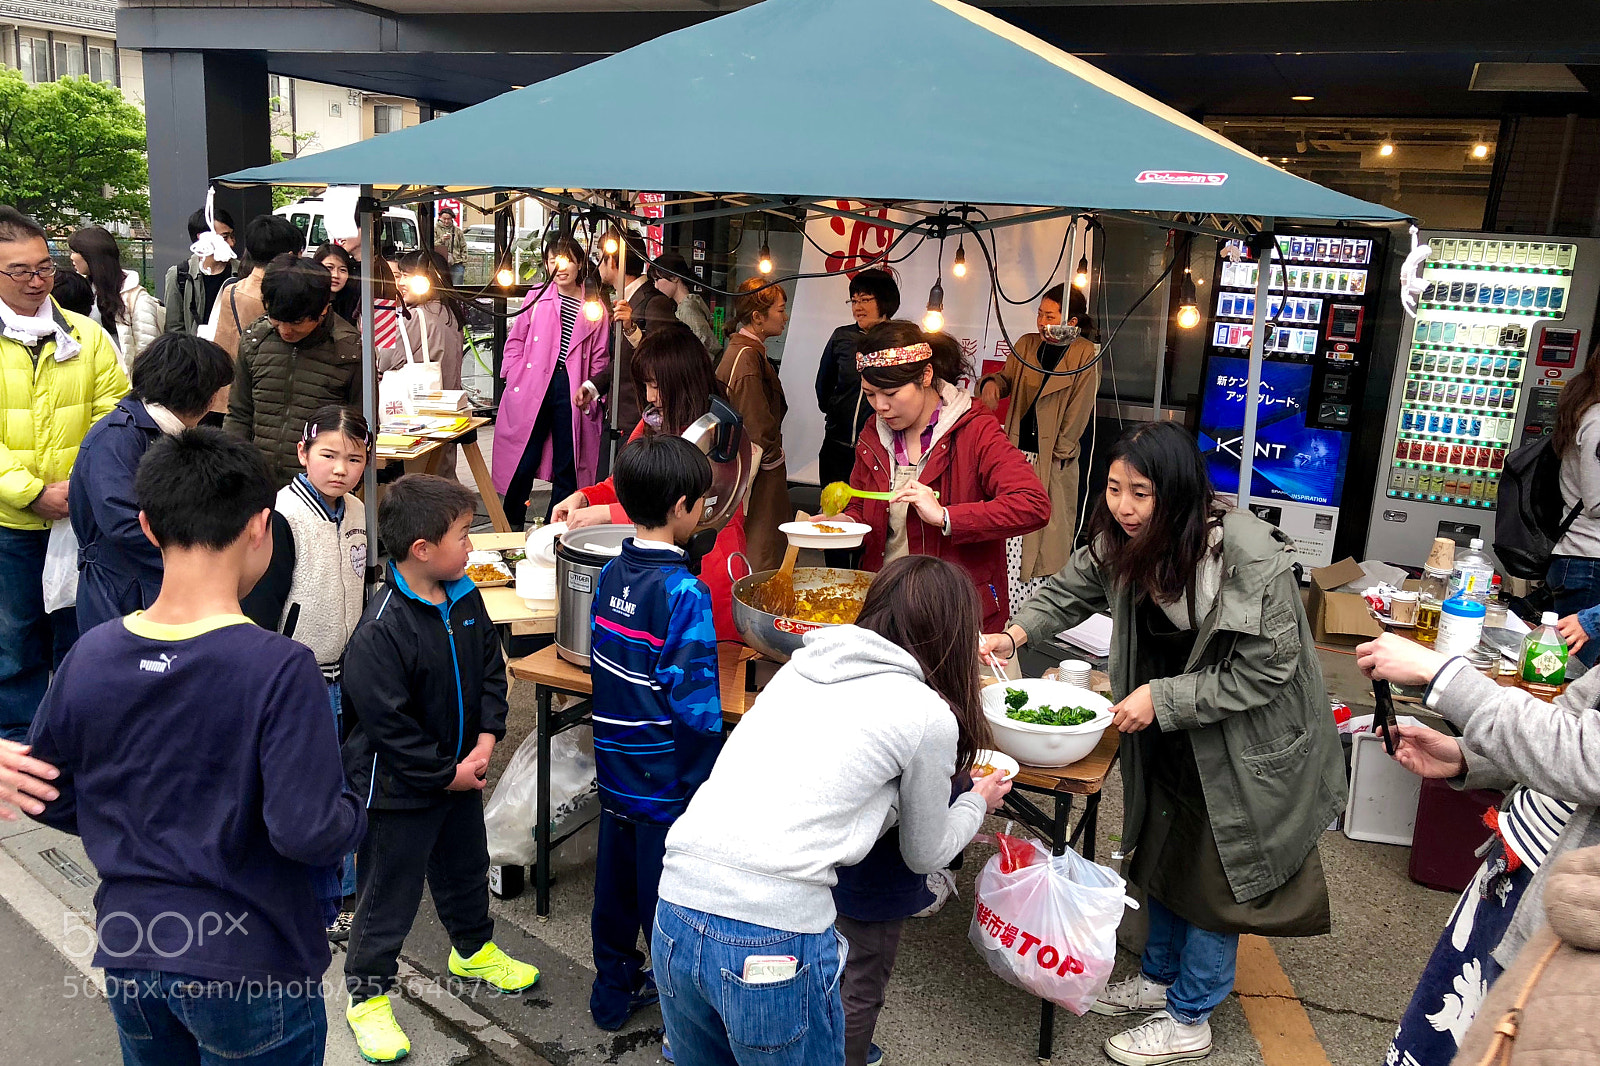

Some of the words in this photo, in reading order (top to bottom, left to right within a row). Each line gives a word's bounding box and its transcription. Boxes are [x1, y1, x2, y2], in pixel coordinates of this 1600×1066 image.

[1216, 374, 1275, 391] 新ケンへ、
[1225, 390, 1300, 409] アッグレード。
[1215, 435, 1287, 460] KNT
[1291, 493, 1328, 504] INSPIRATION
[609, 595, 637, 615] KELME
[139, 659, 167, 673] PUMA
[975, 892, 1019, 949] 鮮市場
[1017, 930, 1085, 978] TOP
